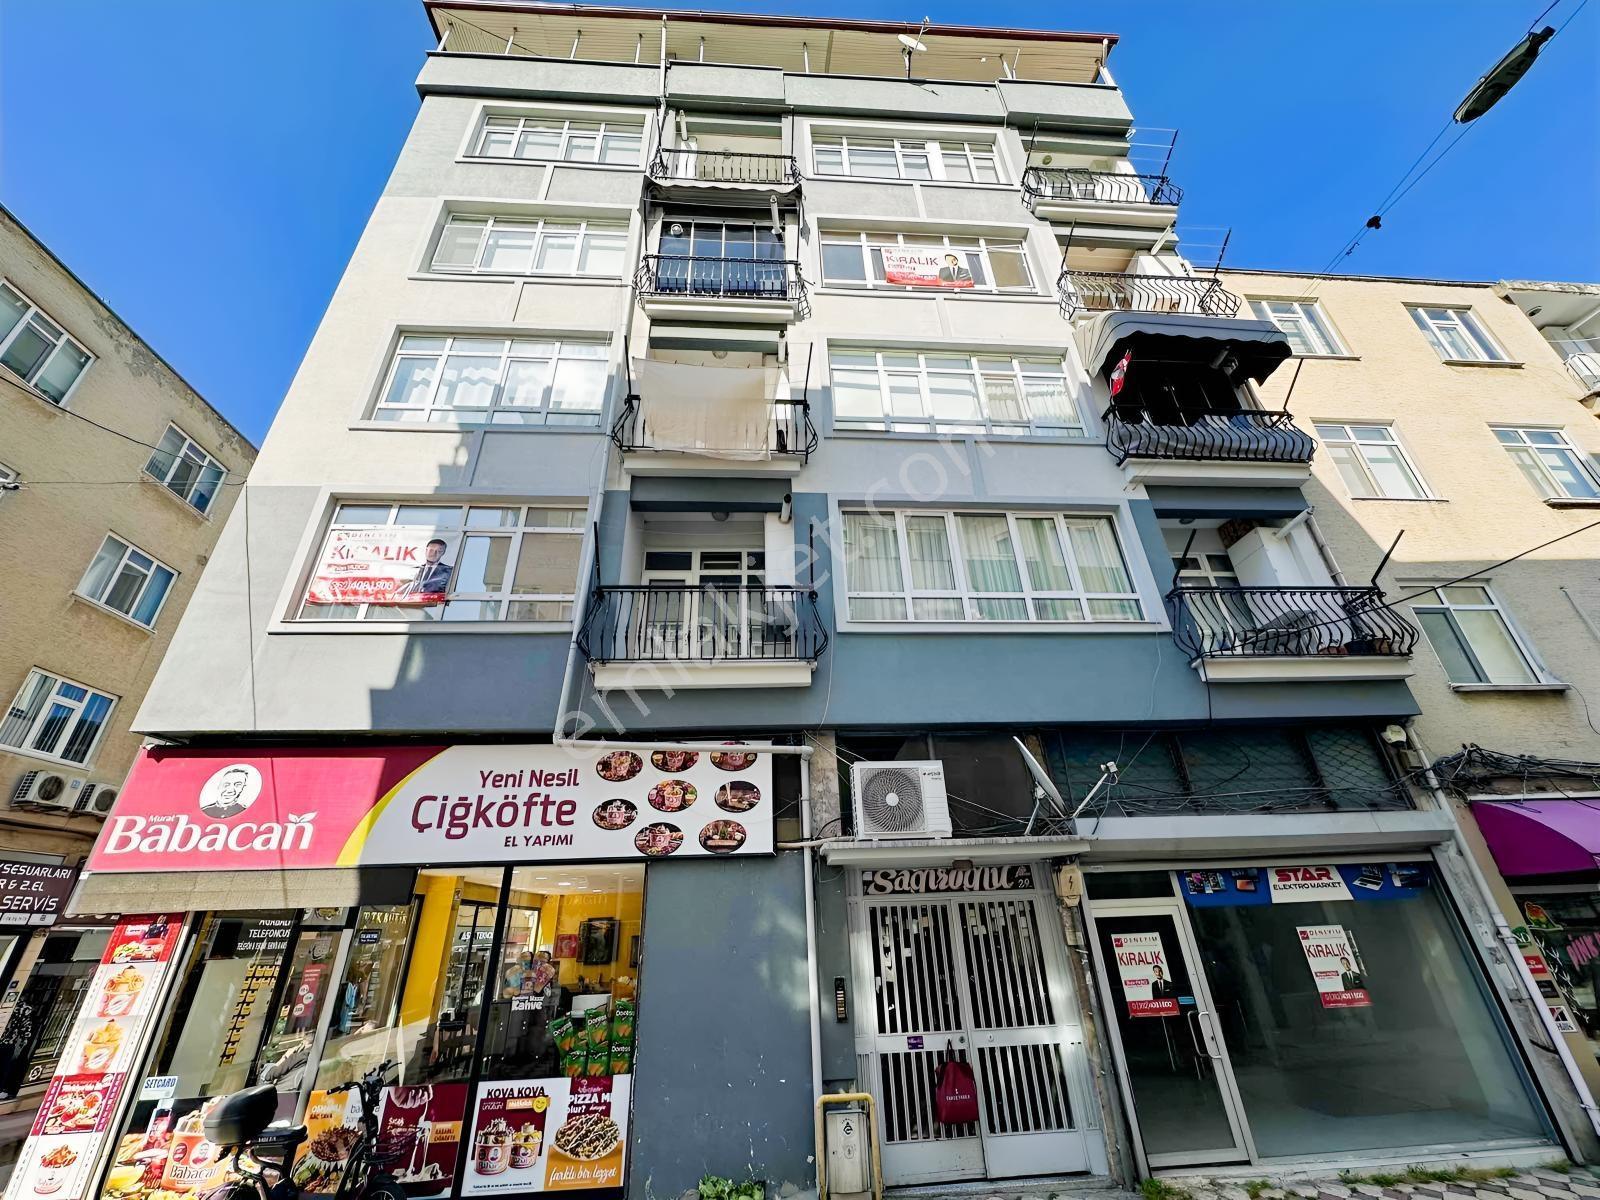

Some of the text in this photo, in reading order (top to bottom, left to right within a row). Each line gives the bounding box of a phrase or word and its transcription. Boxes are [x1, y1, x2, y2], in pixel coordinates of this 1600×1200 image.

[480, 768, 580, 789] Yeni Nesil
[411, 792, 577, 840] Çiğköfte
[504, 834, 574, 847] EL YAPIMI
[1274, 867, 1334, 882] STAR
[0, 895, 59, 911] SERVİS
[487, 1086, 546, 1099] KOVA KOVA
